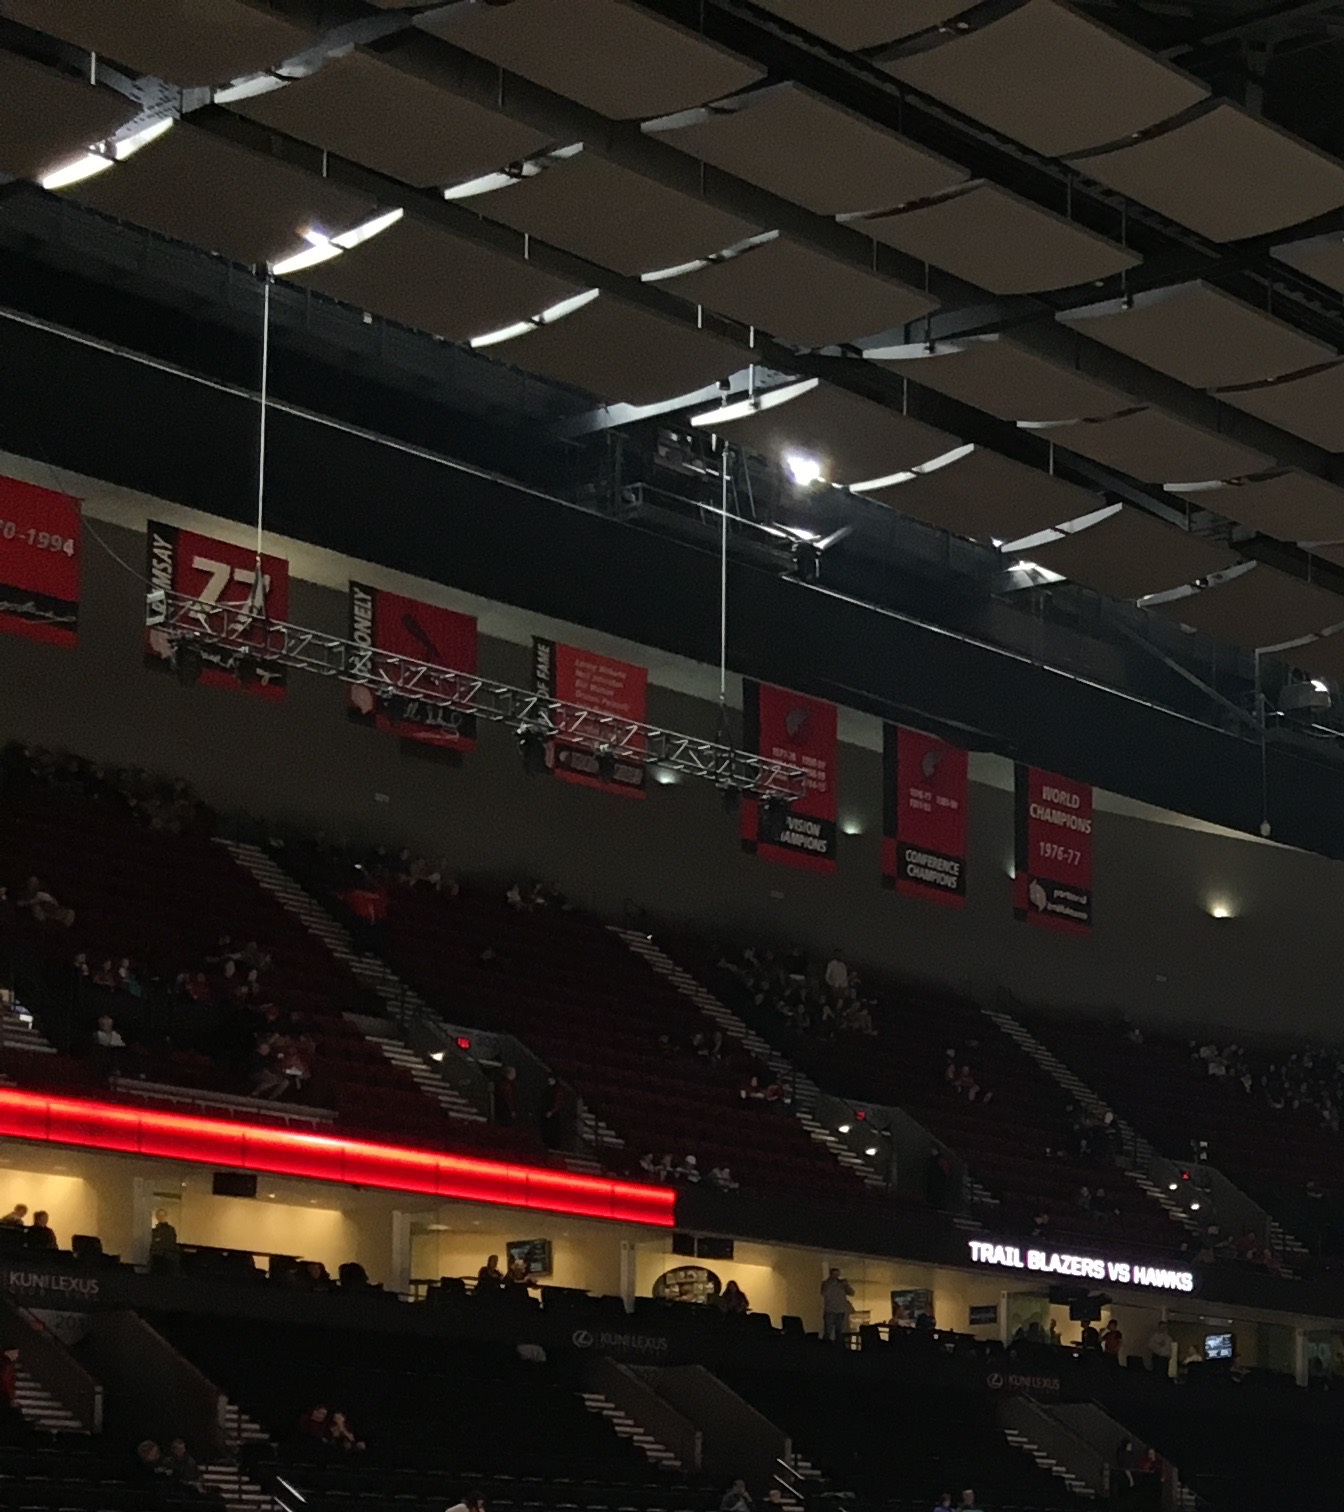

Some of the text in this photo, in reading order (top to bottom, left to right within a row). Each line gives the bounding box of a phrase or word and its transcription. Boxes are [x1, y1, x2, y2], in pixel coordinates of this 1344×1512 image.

[190, 555, 272, 634] 77
[1042, 786, 1081, 810] WORLD
[1029, 802, 1092, 835] CHAMPIONS
[904, 849, 961, 877] CONFERENCE
[1038, 841, 1082, 866] 1976-77
[905, 864, 958, 889] CHAMPIONS
[968, 1240, 1194, 1293] TRAIL BLAZERS VS HAWKS
[9, 1270, 100, 1295] KUNI LEXUS
[631, 1335, 669, 1351] LEXUS
